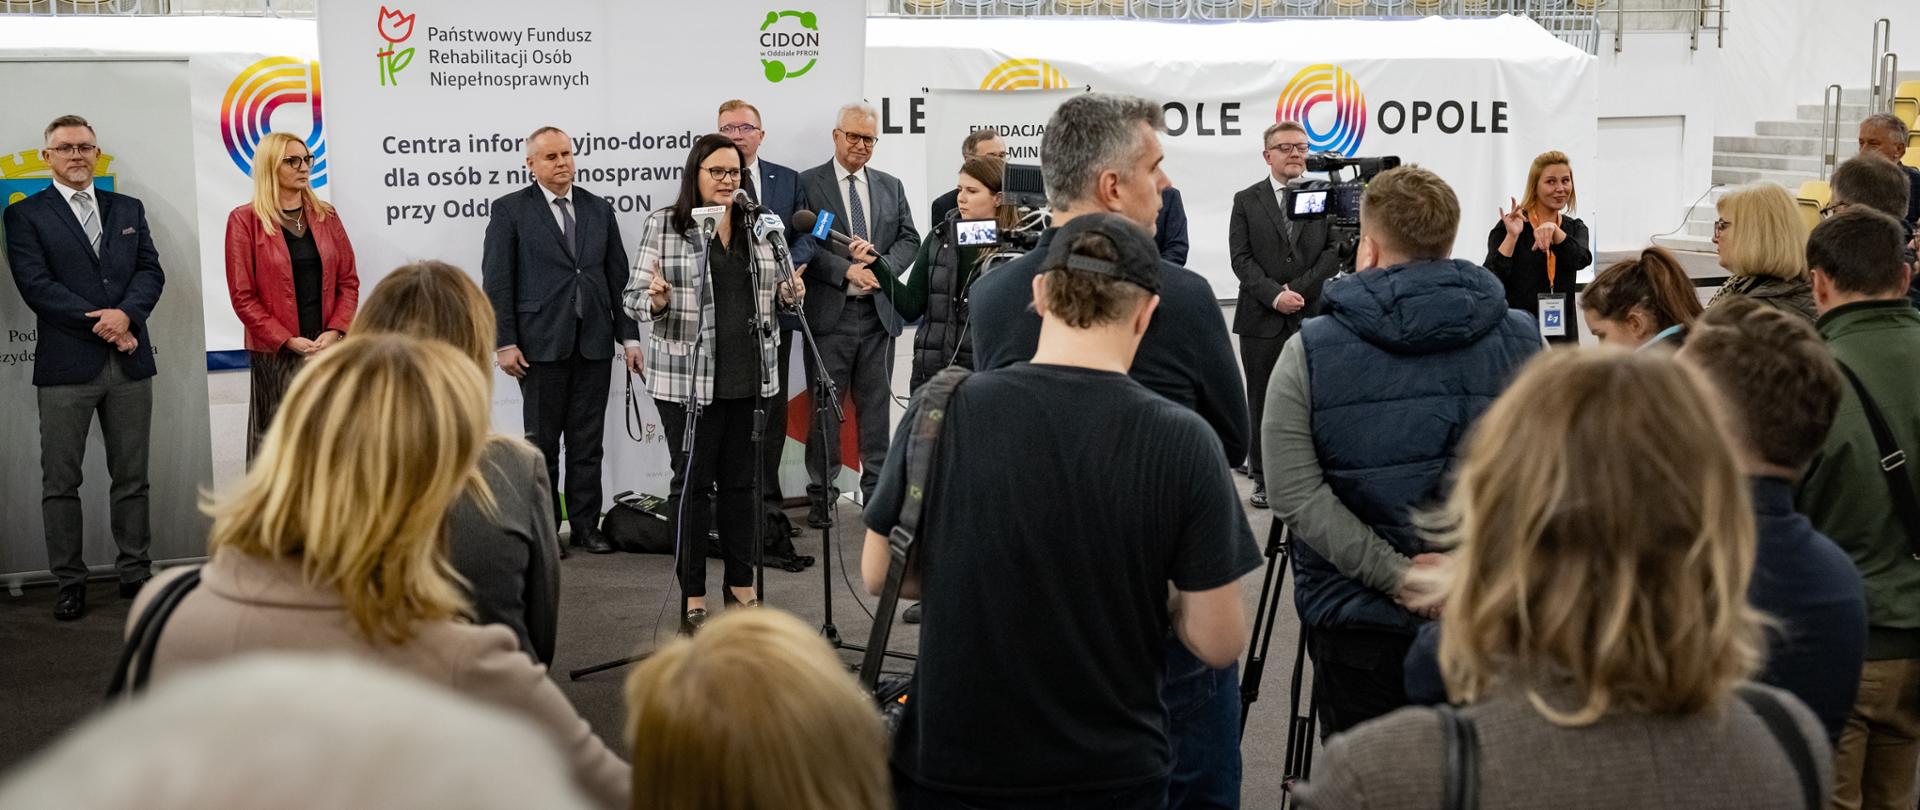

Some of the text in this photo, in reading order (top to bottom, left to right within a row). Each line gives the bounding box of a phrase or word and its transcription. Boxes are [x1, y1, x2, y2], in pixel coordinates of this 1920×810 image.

[428, 26, 592, 46] Państwowy Fundusz
[760, 32, 819, 47] CIDON
[429, 49, 572, 68] Rehabilitacji Osób
[430, 71, 589, 90] Niepełnosprawnych
[882, 97, 925, 134] LE
[1162, 101, 1241, 137] OLE
[1377, 100, 1508, 135] OPOLE
[382, 136, 461, 154] Centra
[1008, 146, 1038, 158] MIN
[384, 167, 420, 187] dla
[427, 166, 482, 186] osób
[488, 170, 499, 185] z
[386, 194, 651, 226] przy Odd RON
[8, 328, 37, 342] Pod
